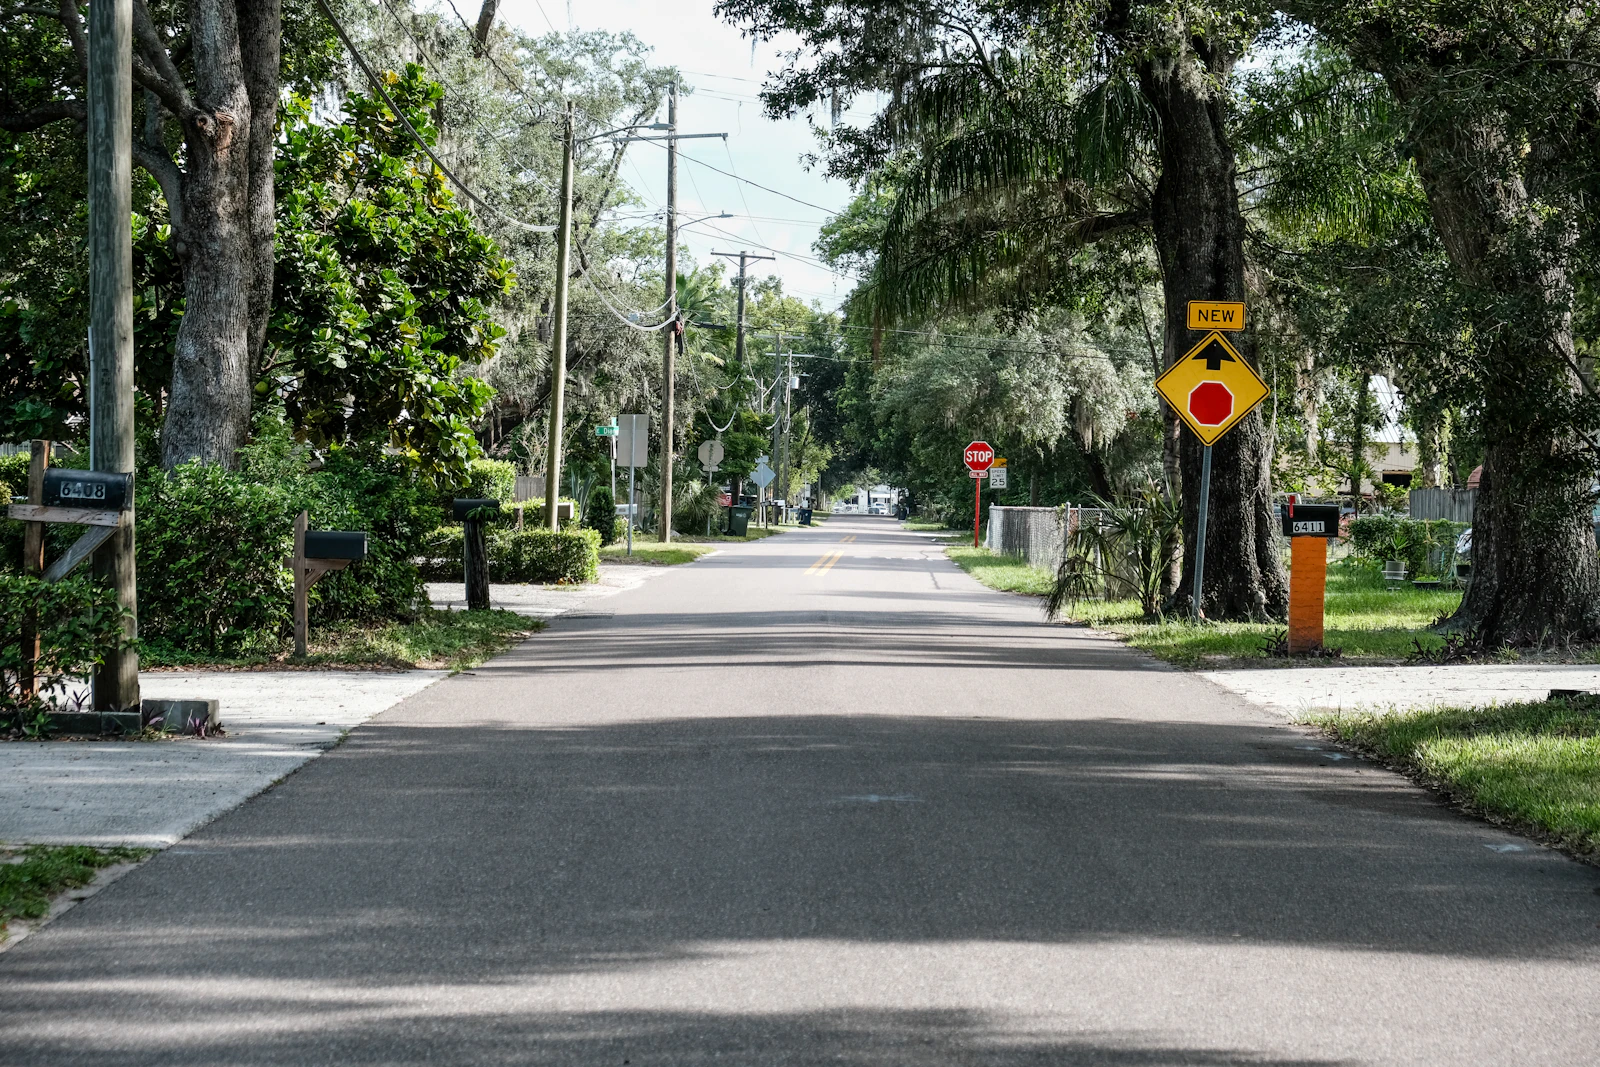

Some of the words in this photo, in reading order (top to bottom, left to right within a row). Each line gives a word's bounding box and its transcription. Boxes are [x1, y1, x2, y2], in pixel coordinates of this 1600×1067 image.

[1198, 309, 1235, 323] NEW
[966, 451, 992, 462] STOP
[991, 478, 1005, 486] 25
[62, 482, 104, 498] 6408
[1294, 522, 1323, 532] 6411
